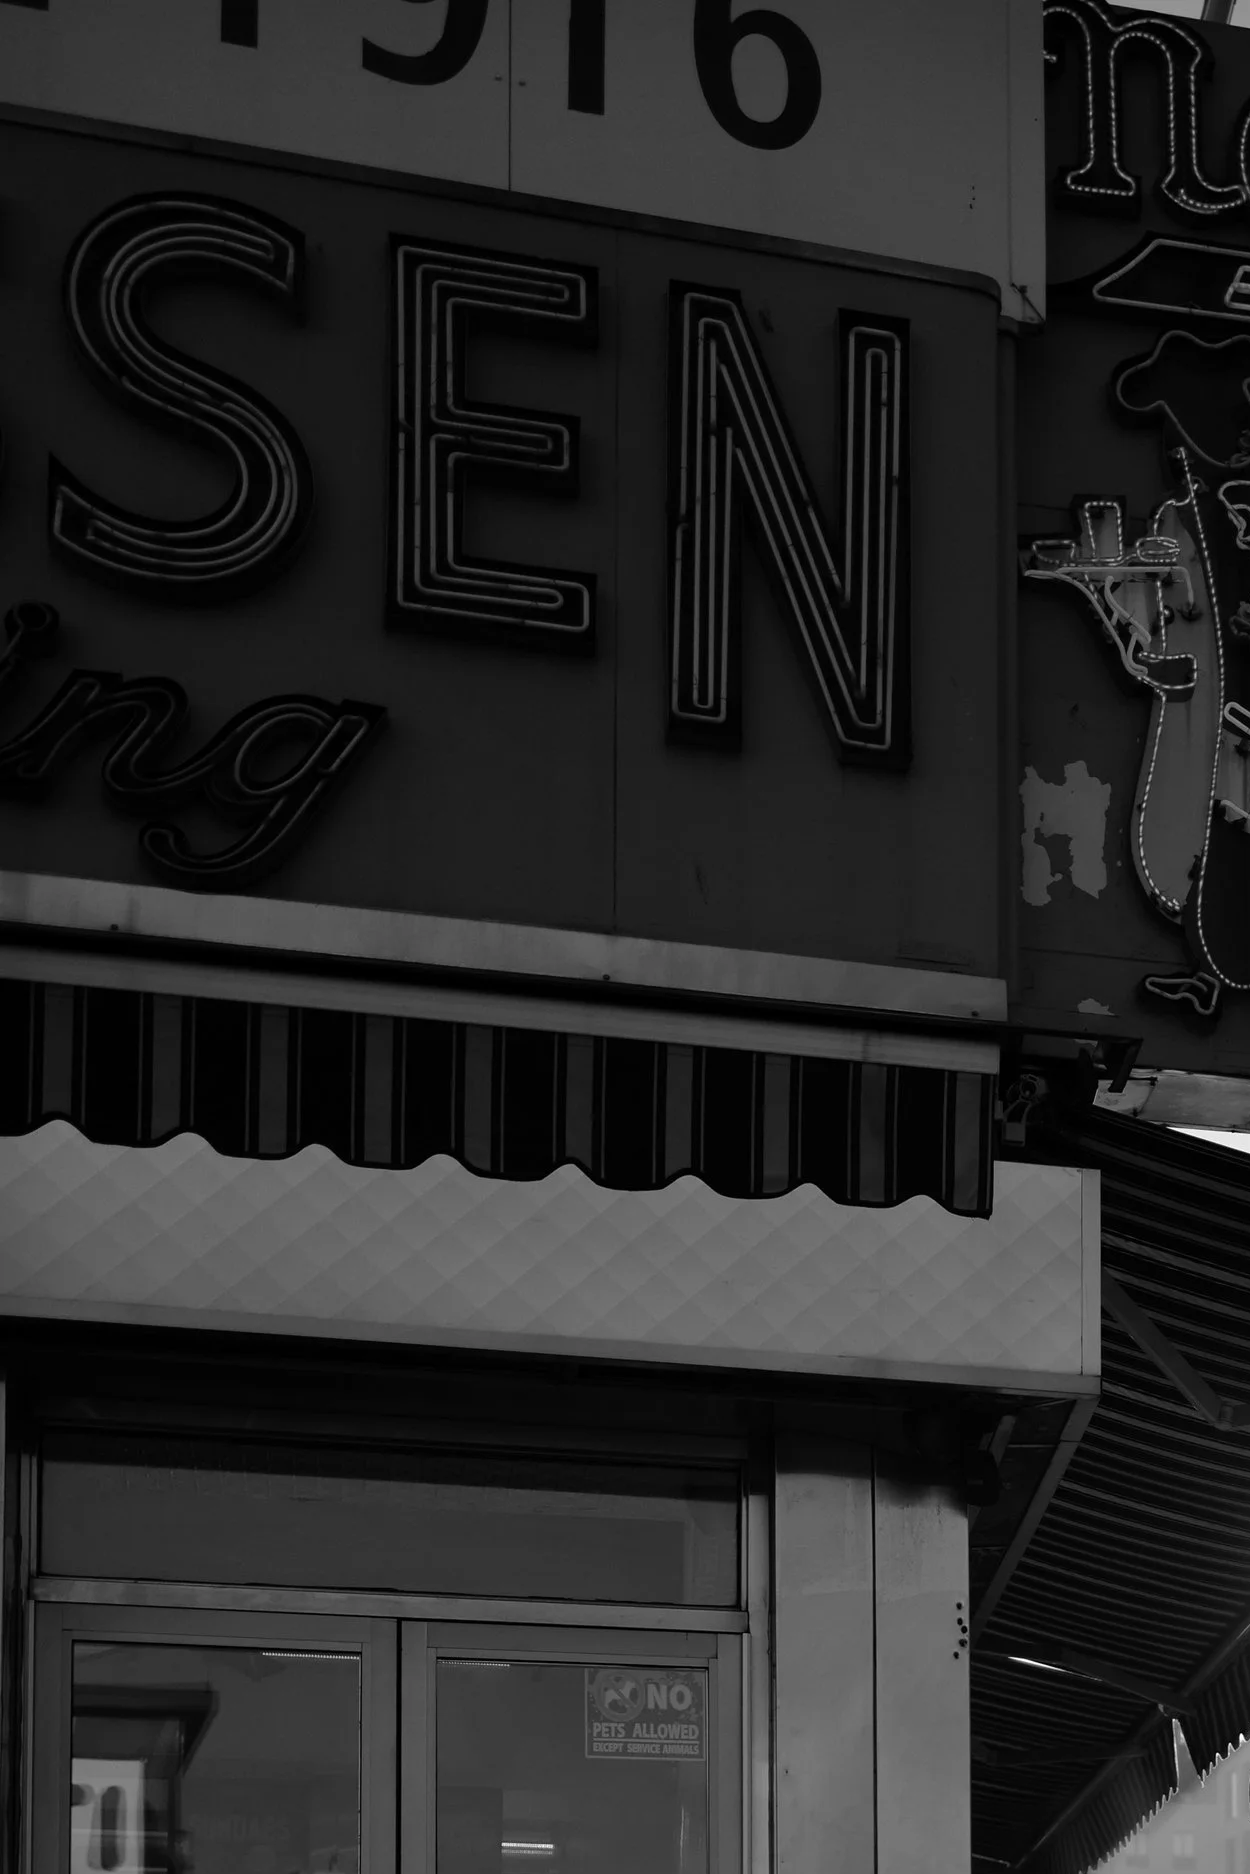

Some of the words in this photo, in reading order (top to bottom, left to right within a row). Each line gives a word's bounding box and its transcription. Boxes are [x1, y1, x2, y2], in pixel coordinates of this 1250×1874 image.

[646, 1683, 692, 1711] NO
[592, 1722, 626, 1738] PETS
[632, 1723, 699, 1740] ALLOWED
[592, 1742, 624, 1753] EXCEPT
[626, 1743, 661, 1755] SERVICE
[662, 1744, 700, 1756] ANIMALS
